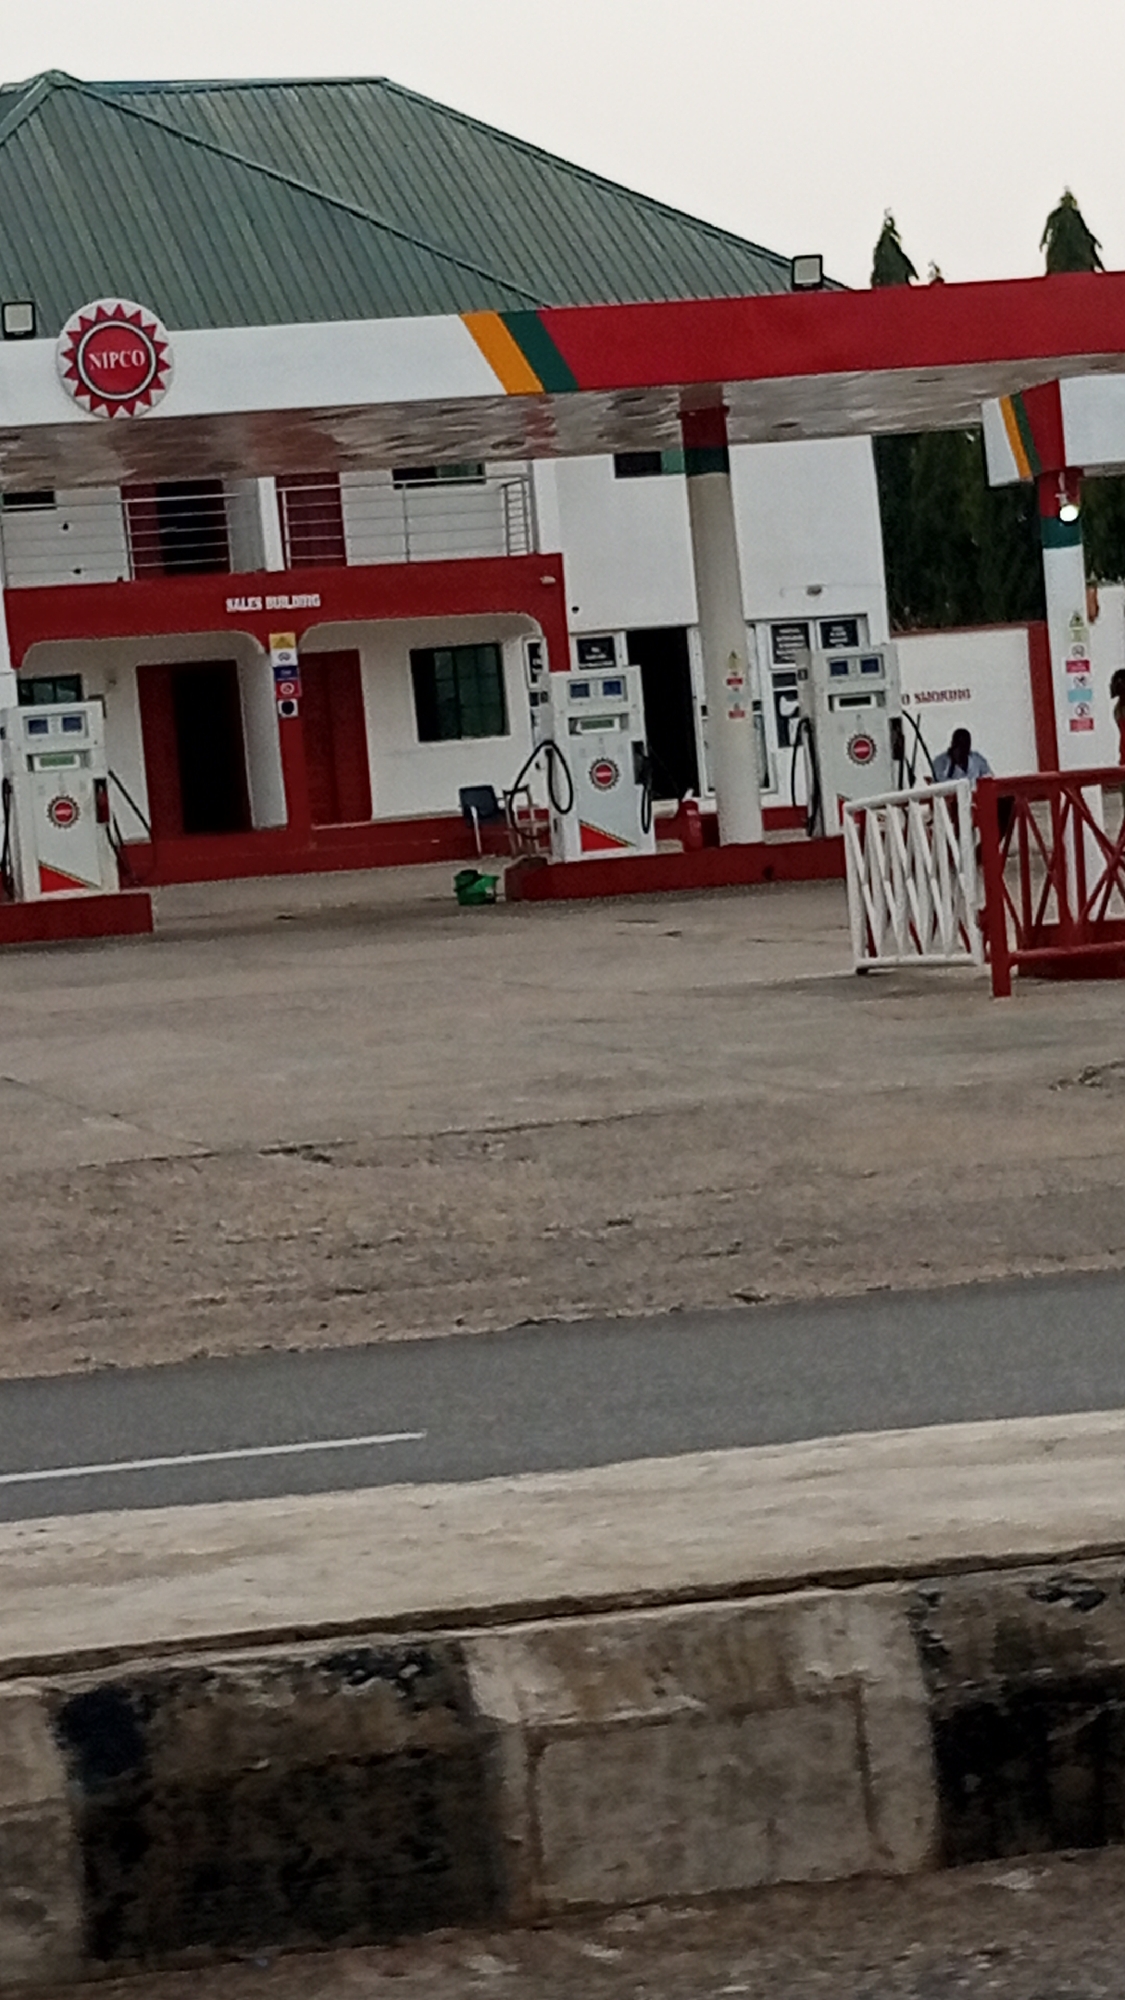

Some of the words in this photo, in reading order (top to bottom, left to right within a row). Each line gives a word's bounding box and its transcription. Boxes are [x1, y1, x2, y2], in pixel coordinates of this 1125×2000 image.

[88, 350, 146, 370] NIPCO
[226, 596, 263, 613] SALES
[265, 593, 321, 609] BUILDING
